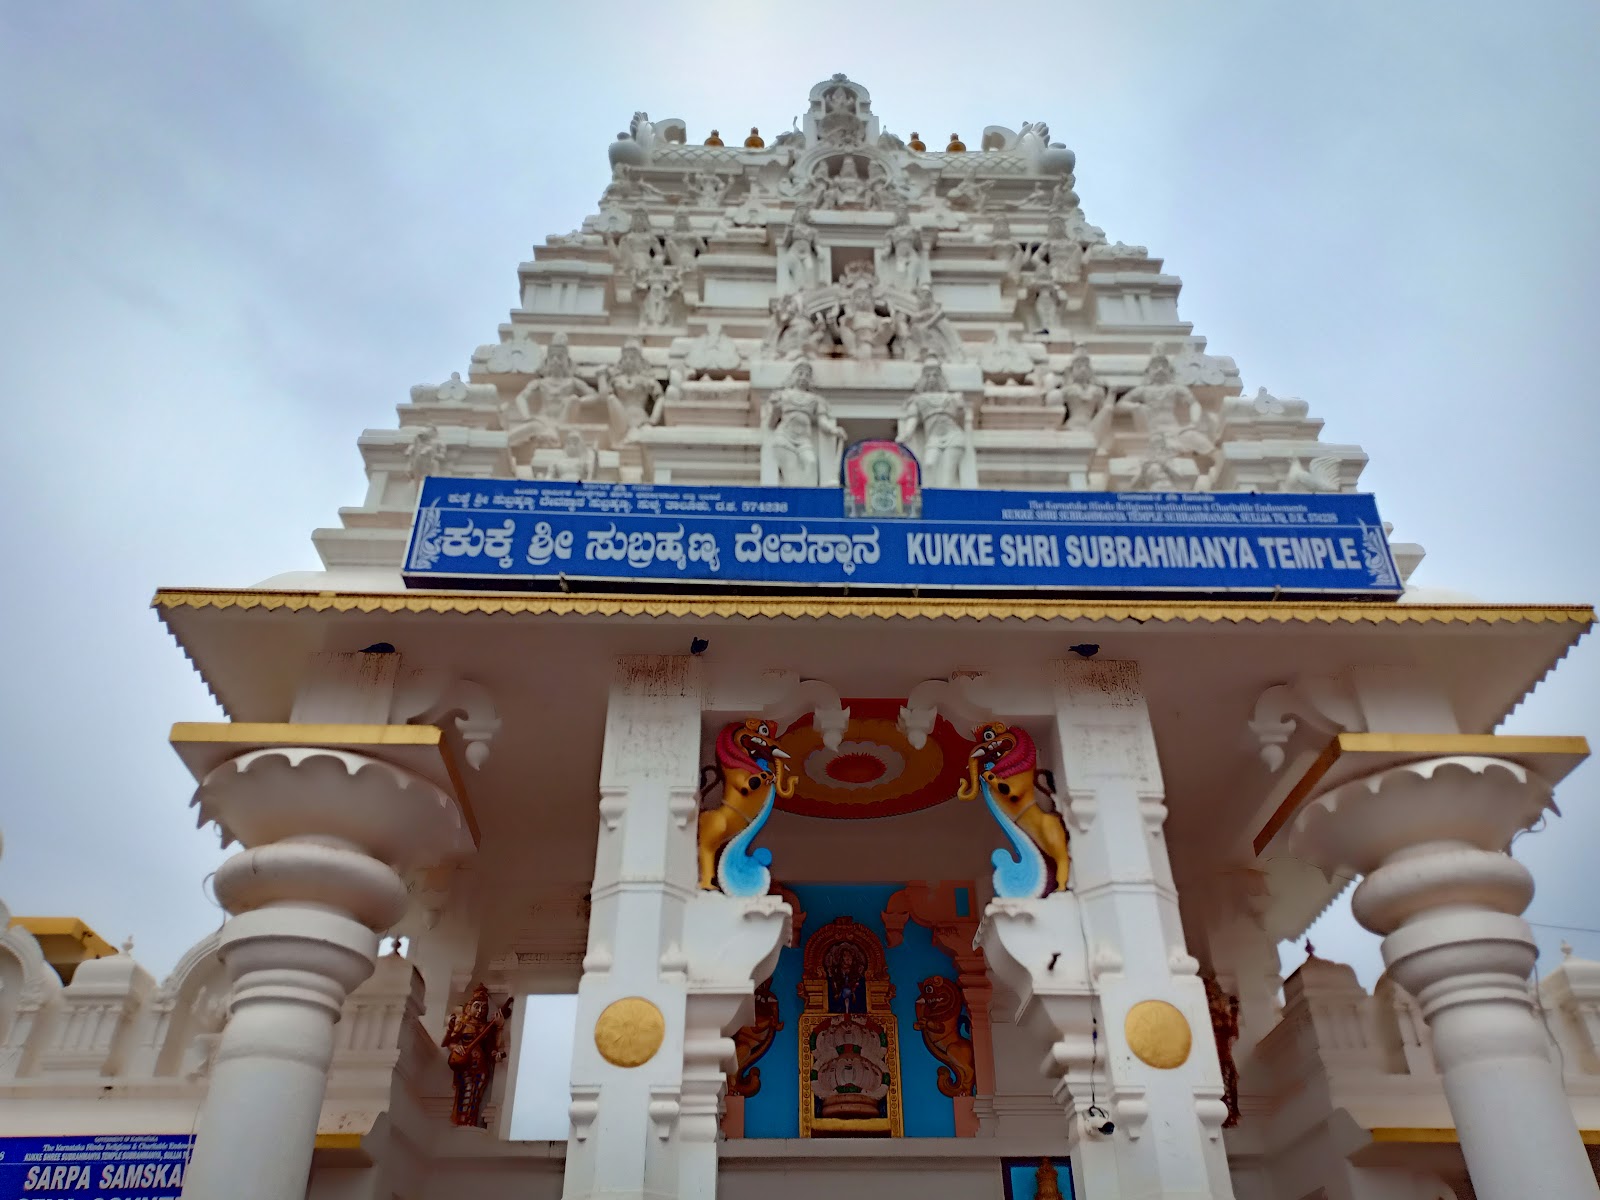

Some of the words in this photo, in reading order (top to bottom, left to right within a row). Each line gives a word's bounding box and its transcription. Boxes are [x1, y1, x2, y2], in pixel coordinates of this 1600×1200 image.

[442, 518, 516, 569] ಕುಕ್ಕೆ
[526, 521, 574, 566] ಶ್ರೀ
[585, 521, 720, 572] ಸುಬ್ರಹ್ಮಣ್ಯ
[734, 523, 881, 576] ದೇವಸ್ಥಾನ
[906, 532, 995, 567] KUKKE
[1000, 534, 1060, 568] SHRI
[1064, 534, 1259, 569] SUBRAHMANYA
[1258, 537, 1362, 570] TEMPLE
[24, 1165, 91, 1190] SARPA
[99, 1163, 184, 1189] SAMSKA
